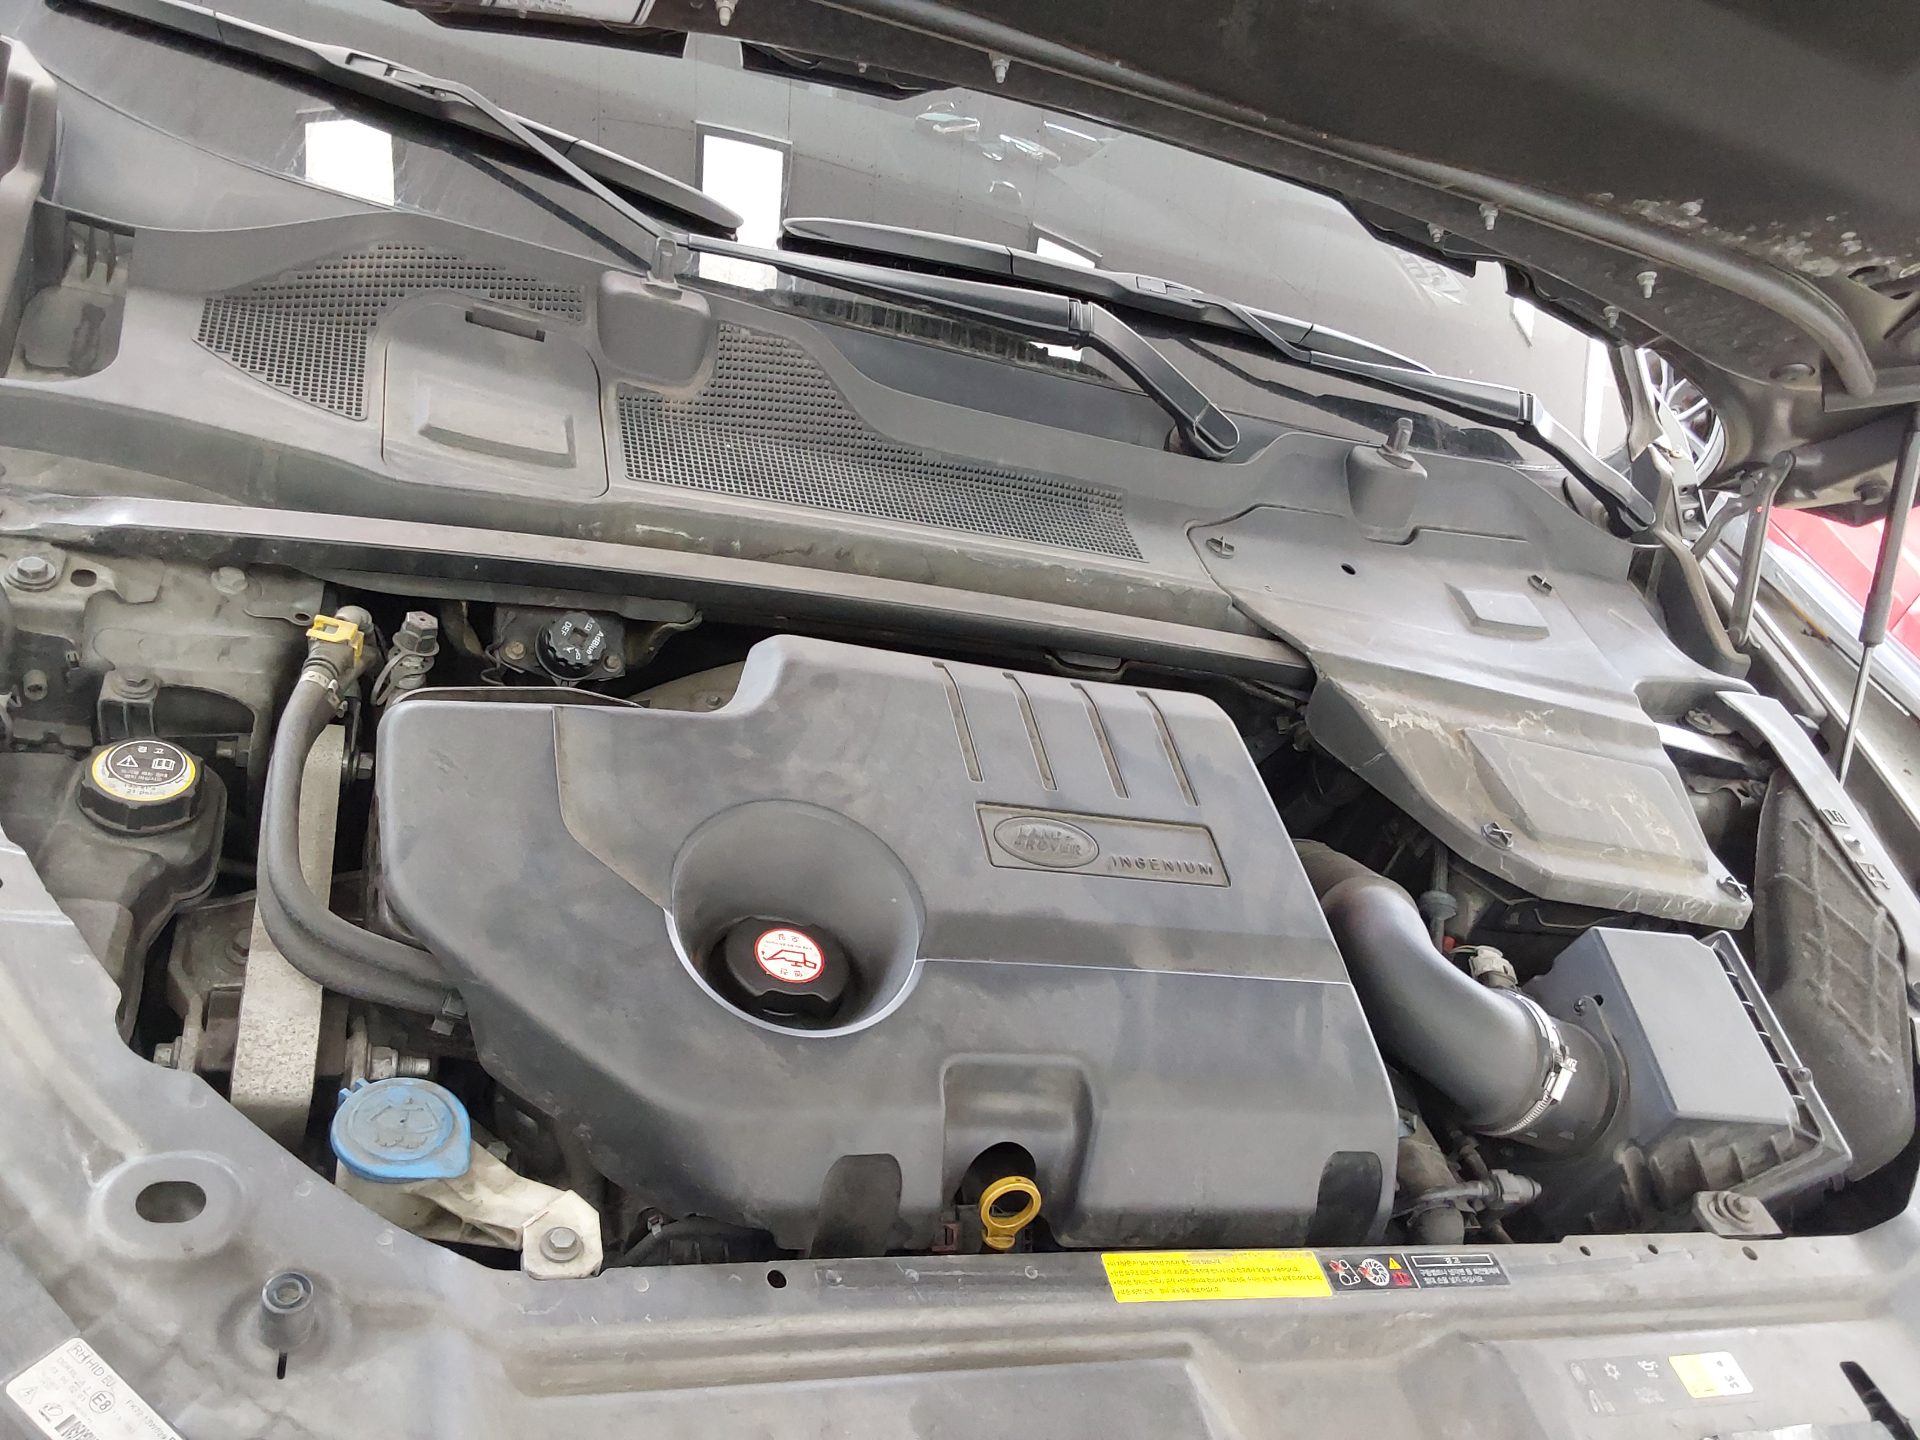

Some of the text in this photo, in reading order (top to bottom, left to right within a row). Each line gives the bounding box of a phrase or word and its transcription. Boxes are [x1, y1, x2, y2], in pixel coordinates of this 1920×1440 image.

[561, 621, 572, 637] DEF
[1110, 854, 1214, 876] INGENIUM
[74, 1344, 90, 1362] RH
[84, 1358, 105, 1377] HID
[92, 1392, 111, 1411] E8
